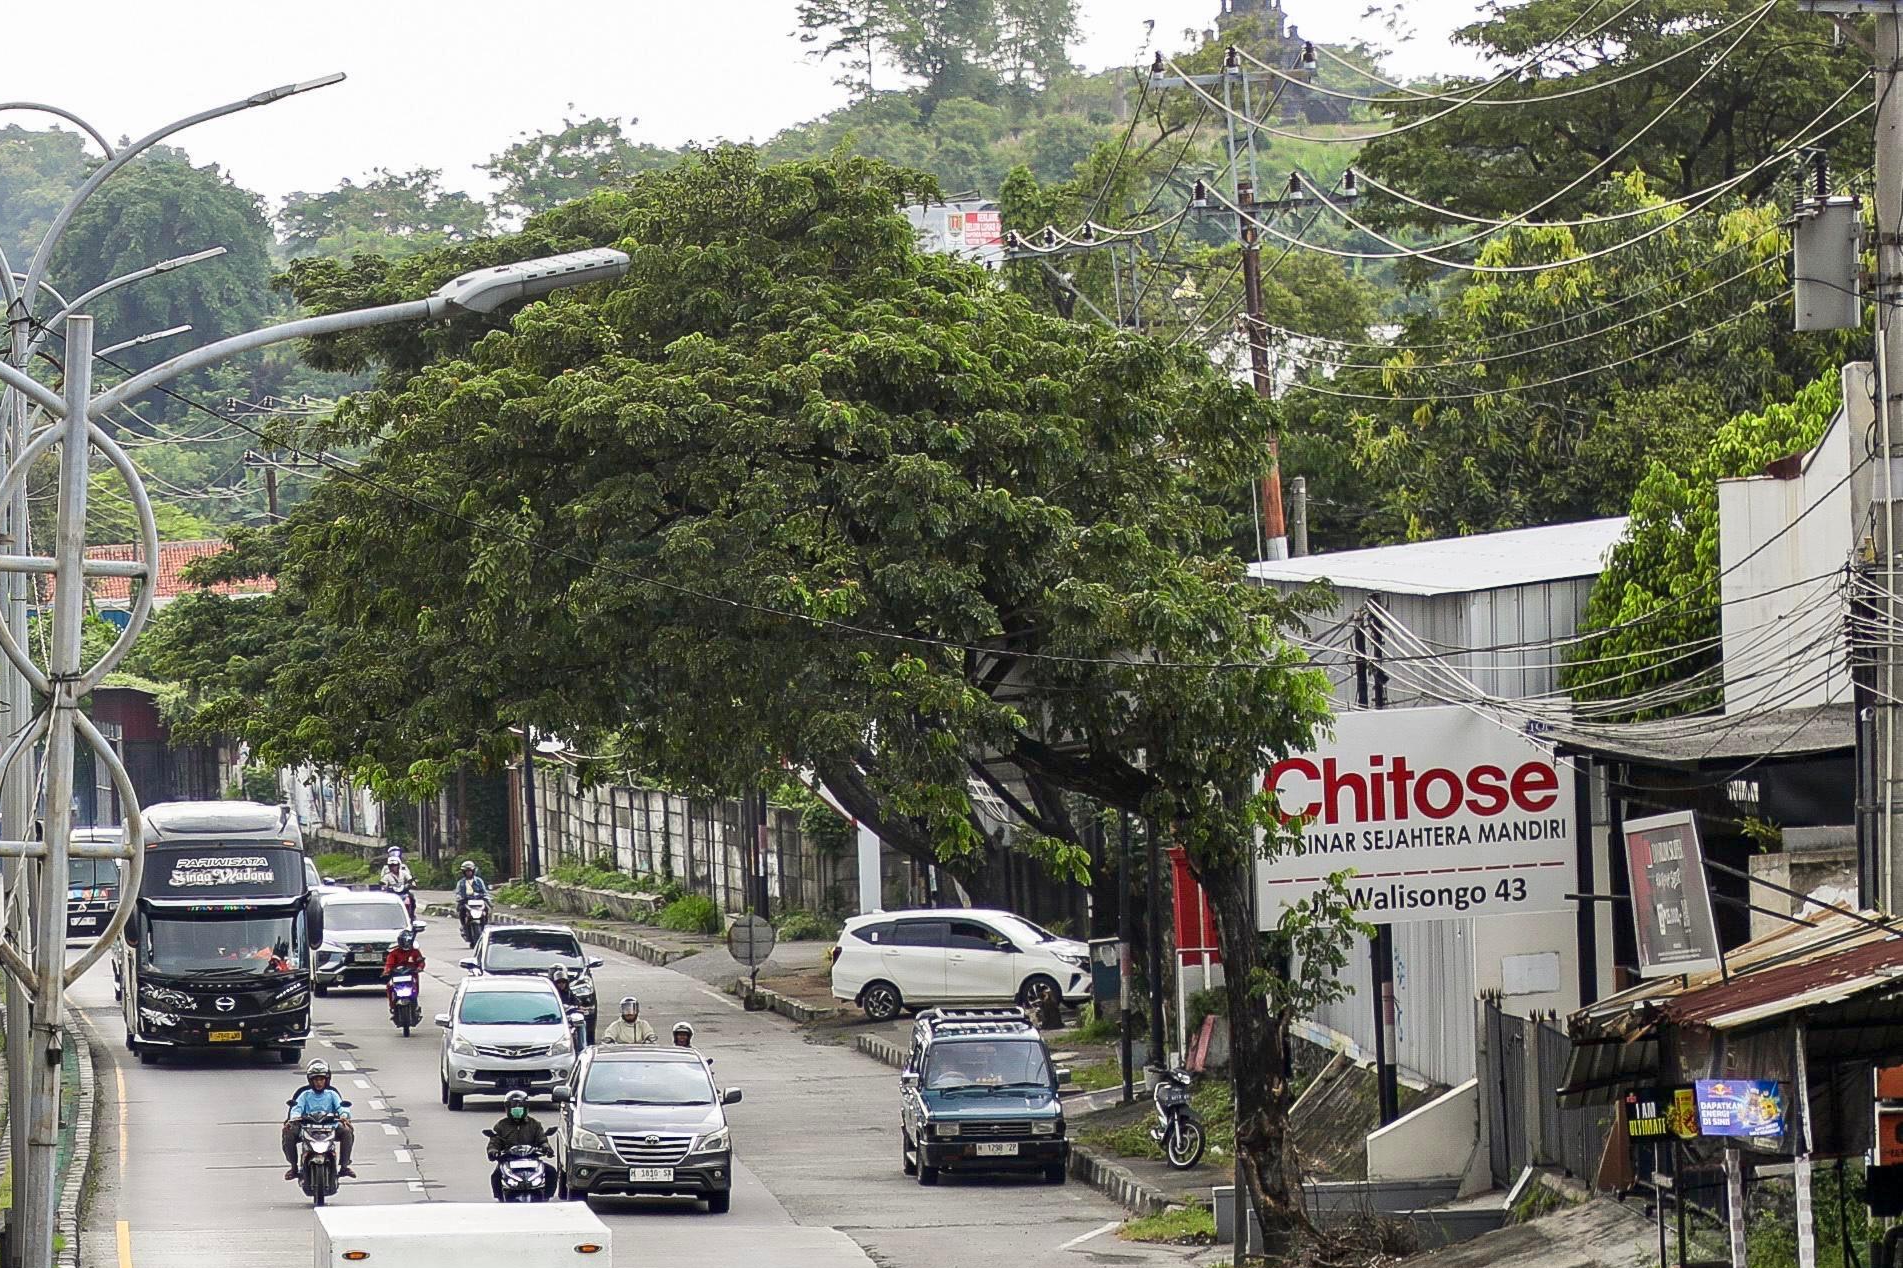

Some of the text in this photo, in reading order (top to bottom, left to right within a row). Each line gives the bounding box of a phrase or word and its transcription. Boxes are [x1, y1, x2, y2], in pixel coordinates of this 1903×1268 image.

[1263, 755, 1559, 826] Chitose
[1301, 832, 1356, 856] SINAR
[1363, 825, 1472, 851] SEJAHTERA
[1478, 818, 1566, 843] MANDIRI
[176, 857, 268, 868] PARIWISATA
[1347, 884, 1487, 911] Walisongo
[1494, 877, 1527, 902] 43
[1641, 1102, 1656, 1118] AM
[1629, 1118, 1666, 1136] ULTIMATE
